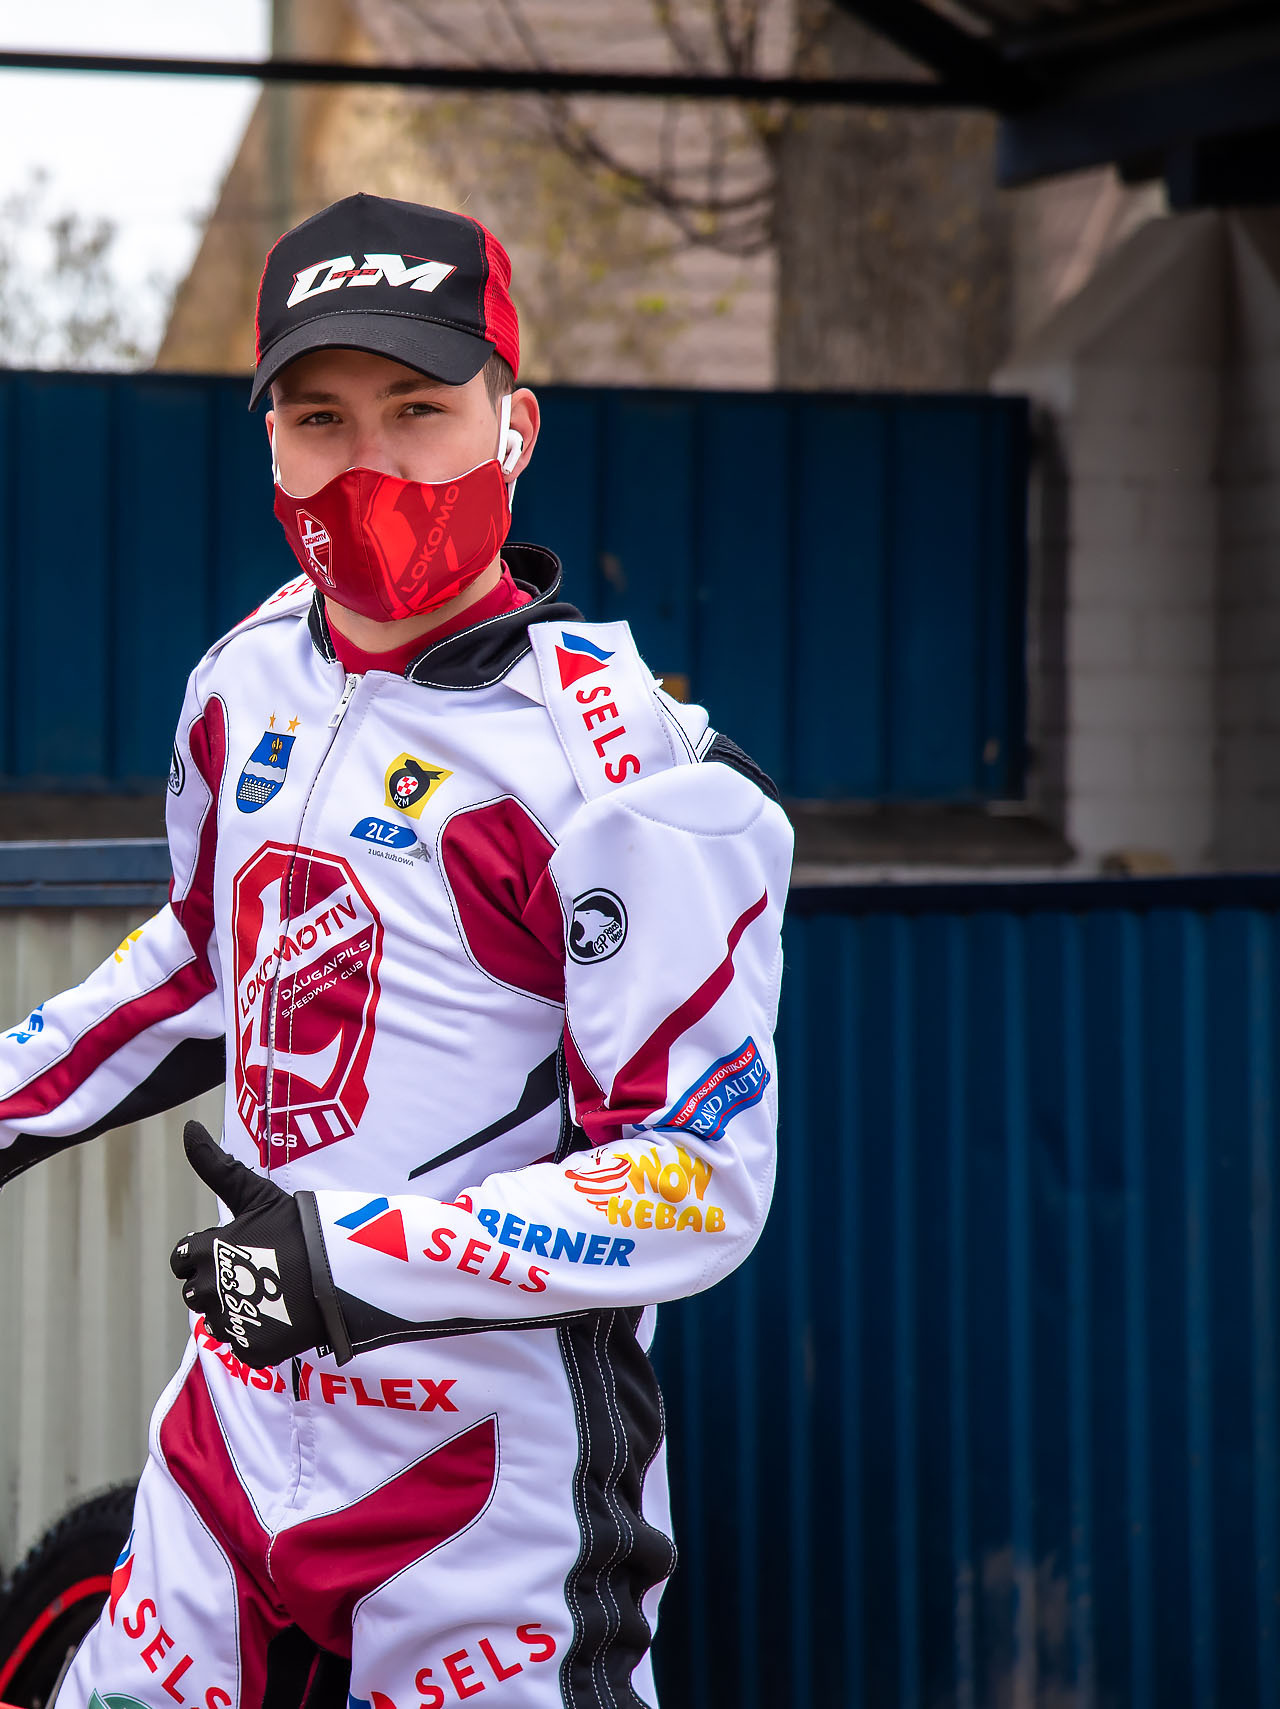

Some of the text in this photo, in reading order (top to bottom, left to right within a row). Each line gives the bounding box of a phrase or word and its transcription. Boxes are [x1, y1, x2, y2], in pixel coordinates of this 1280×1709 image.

[400, 484, 460, 593] LOKOMO
[575, 685, 641, 784] SELS
[393, 793, 410, 807] PZM
[365, 821, 401, 845] 2LŻ
[372, 849, 384, 859] LIGA
[280, 939, 372, 1001] DAUGAVPILS
[594, 933, 609, 955] GP
[281, 960, 365, 1019] SPEEDWAY CLUB
[686, 1057, 764, 1135] RAND AUTO
[613, 1147, 714, 1203] WOW
[477, 1208, 636, 1267] BERNER
[607, 1196, 727, 1233] KEBAB
[422, 1227, 551, 1294] SELS
[320, 1373, 459, 1412] FLEX
[415, 1623, 557, 1709] SELS
